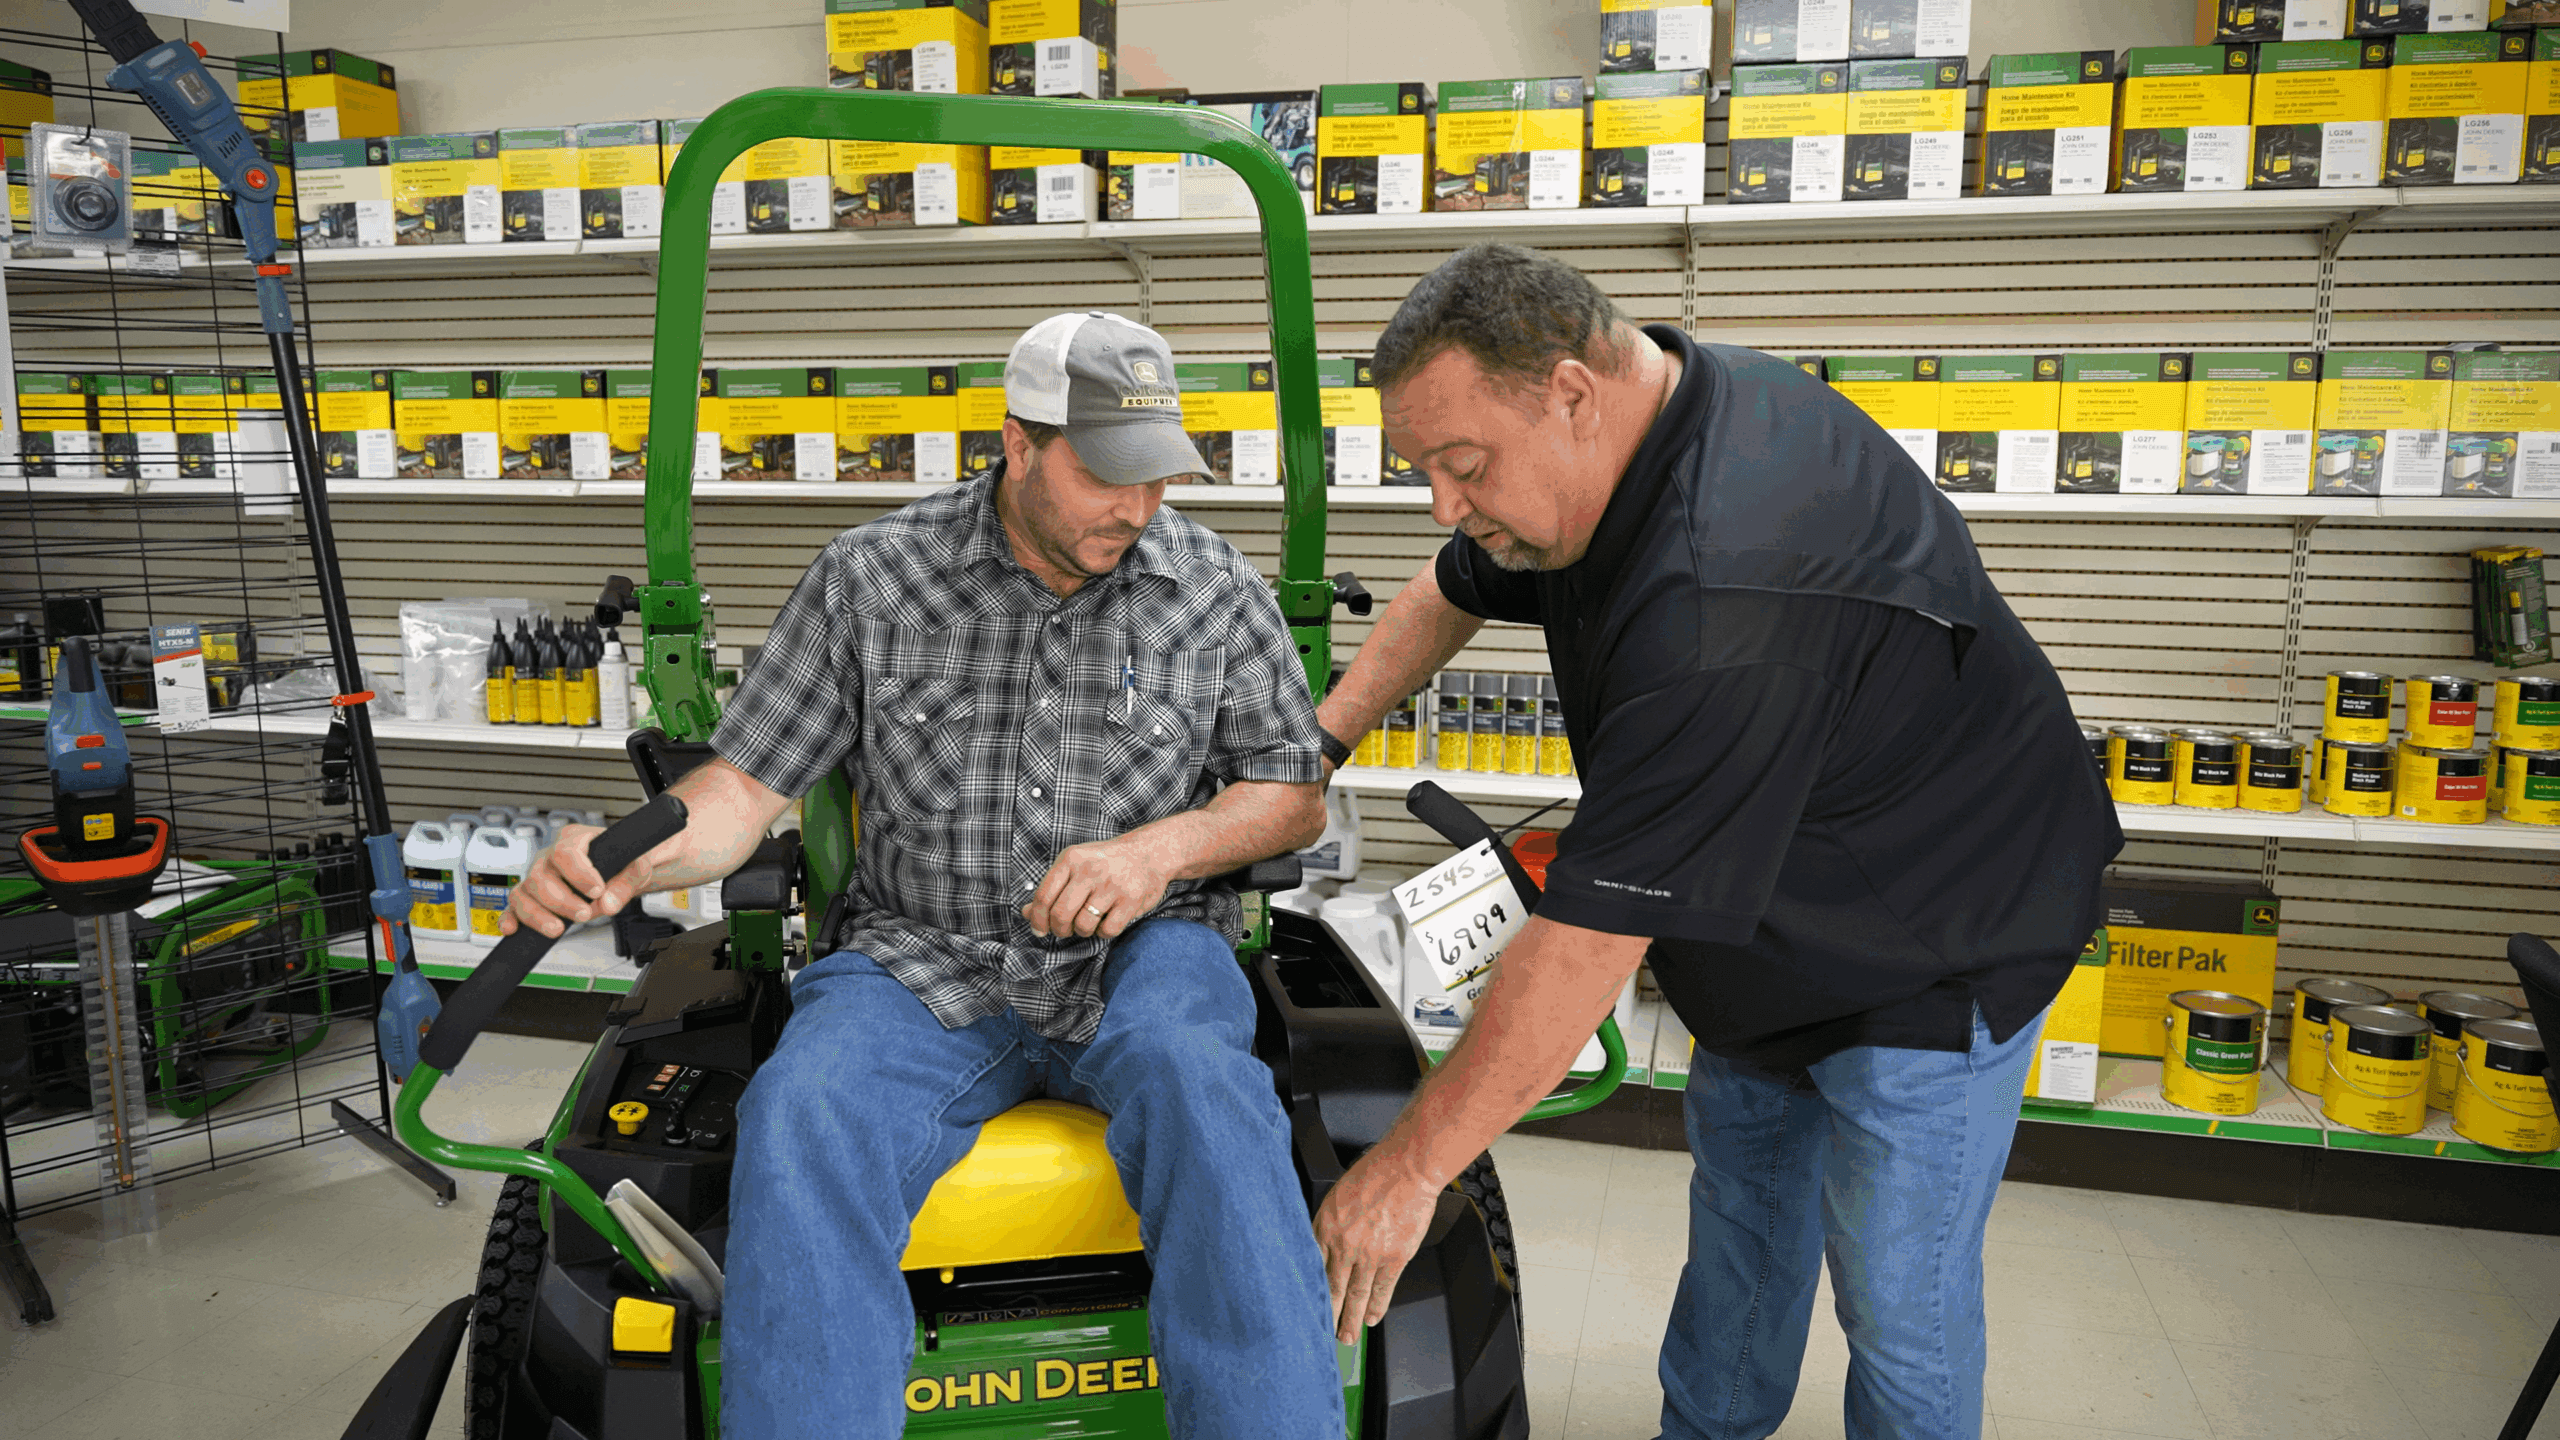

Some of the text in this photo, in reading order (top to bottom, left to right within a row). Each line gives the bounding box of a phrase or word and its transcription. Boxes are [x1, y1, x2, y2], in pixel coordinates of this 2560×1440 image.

[165, 627, 192, 637] SENIX
[1594, 879, 1672, 898] OMNI-SHADE
[2107, 941, 2228, 973] Filter Pak
[2196, 1048, 2219, 1059] Classic
[2220, 1051, 2239, 1059] Green
[2355, 1064, 2364, 1073] Ag
[2389, 1068, 2408, 1076] Yellow
[2494, 1081, 2504, 1090] Ag
[2513, 1084, 2527, 1092] Turf
[1040, 1302, 1130, 1316] ComfortGlide
[903, 1356, 1161, 1413] OHN DEE
